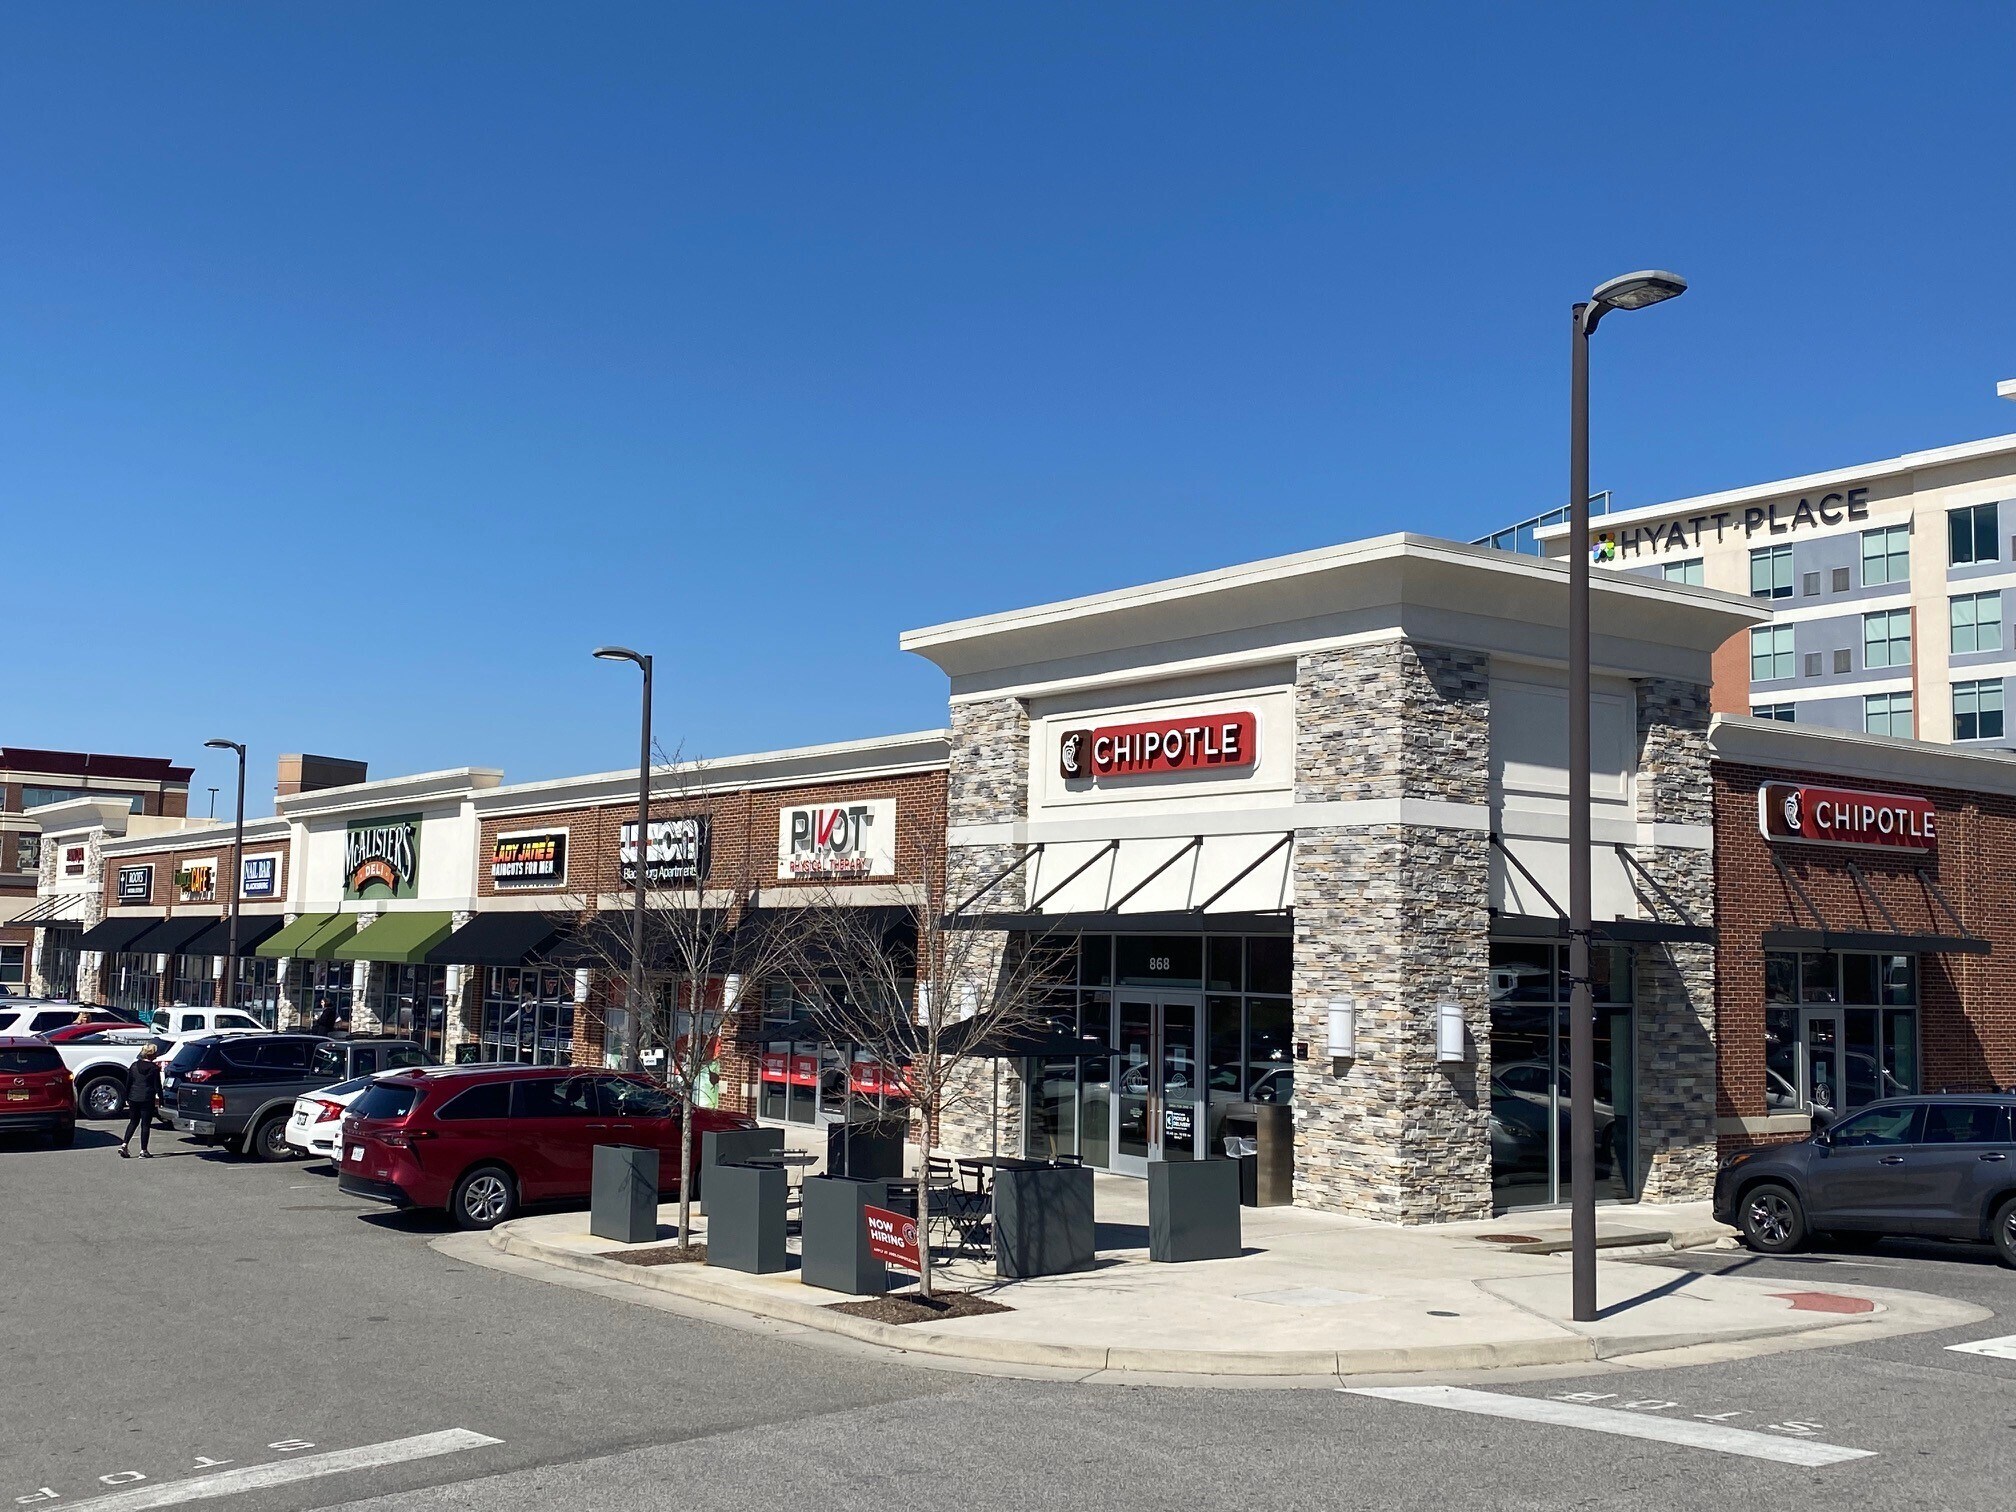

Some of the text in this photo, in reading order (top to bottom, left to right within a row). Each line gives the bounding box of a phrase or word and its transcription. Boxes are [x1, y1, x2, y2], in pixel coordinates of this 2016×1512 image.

[1620, 487, 1869, 558] HYATT PLACE
[1094, 723, 1239, 765] CHIPOTLE
[1816, 801, 1936, 838] CHIPOTLE
[791, 806, 867, 854] PIVOT
[492, 844, 519, 862] LADY
[245, 860, 271, 879] NAIL BAR
[365, 864, 384, 876] DELI
[491, 860, 554, 876] HAIRCUTS FOR MEN
[789, 858, 867, 873] PHYSICAL THERAPY
[191, 867, 209, 892] CAFE
[1149, 957, 1170, 970] 868
[868, 1216, 893, 1233] NOW
[870, 1229, 906, 1248] HIRING
